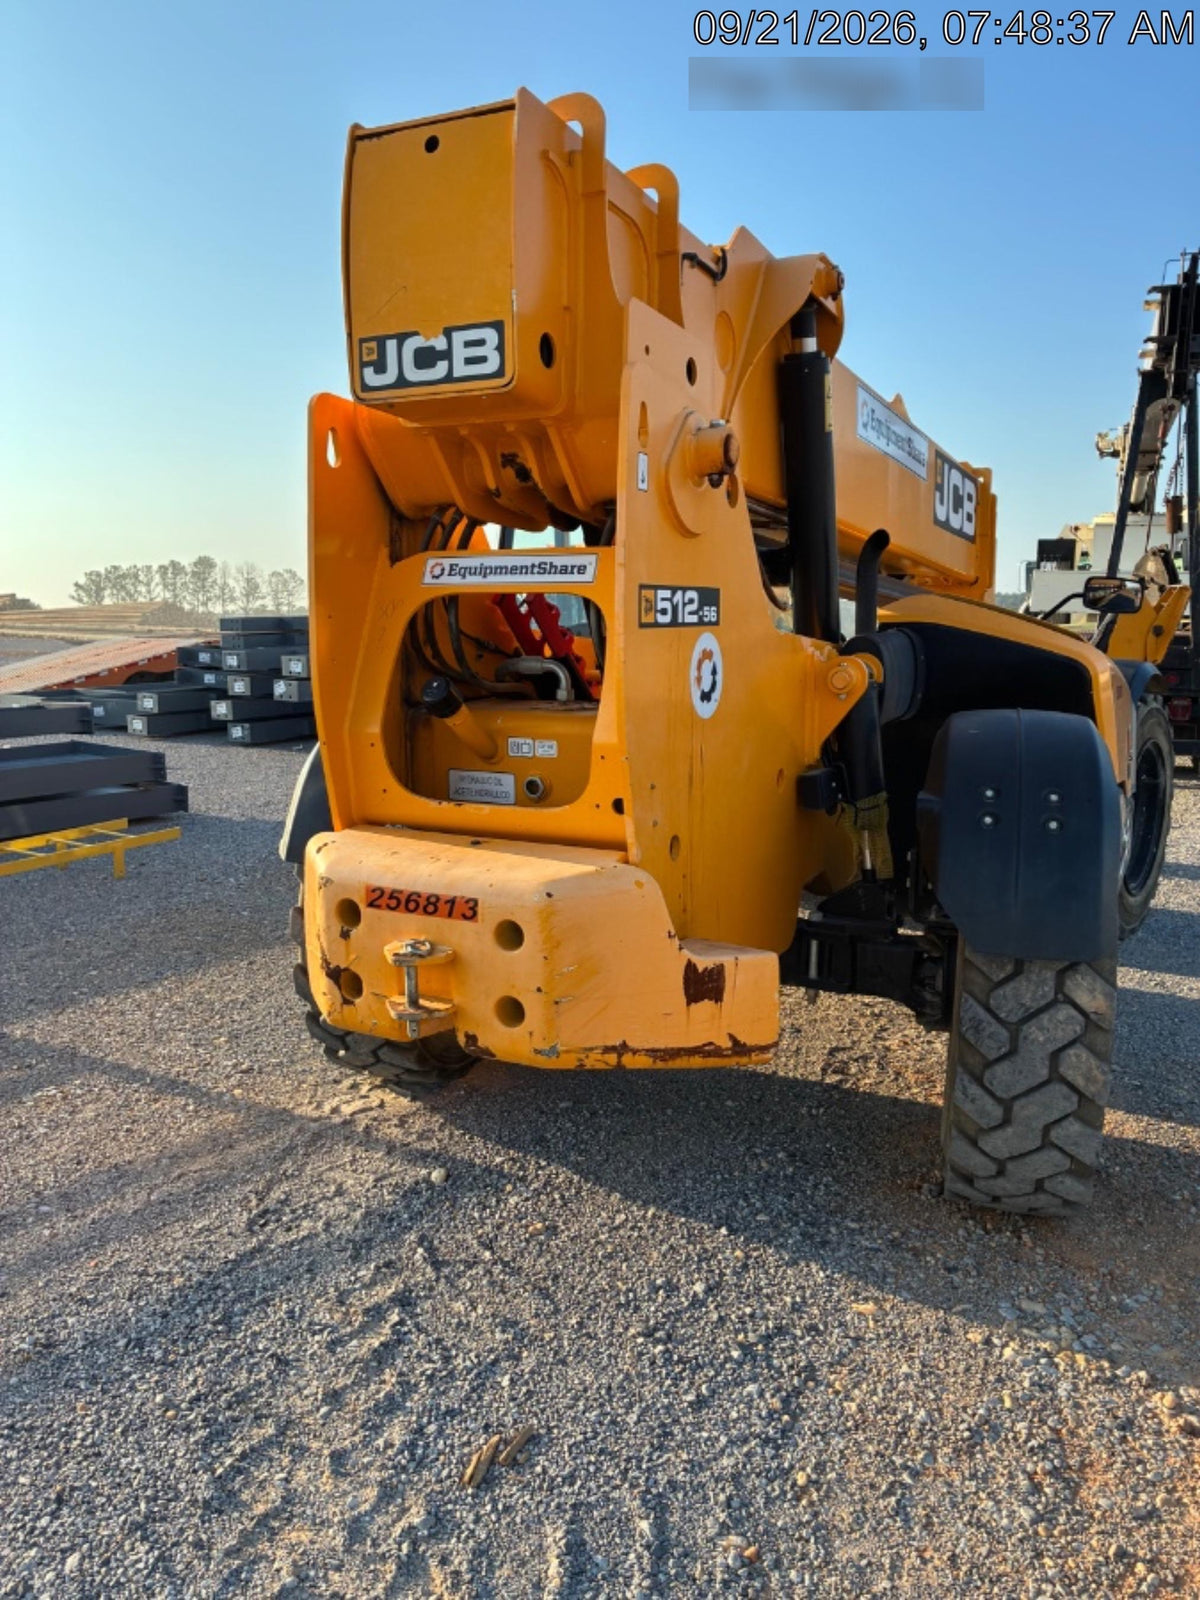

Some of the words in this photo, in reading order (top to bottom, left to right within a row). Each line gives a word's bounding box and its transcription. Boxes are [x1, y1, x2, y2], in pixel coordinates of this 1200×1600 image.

[362, 327, 501, 388] JCB
[934, 461, 977, 537] JCB
[447, 561, 587, 579] EquipmentShare
[367, 886, 479, 920] 256813
